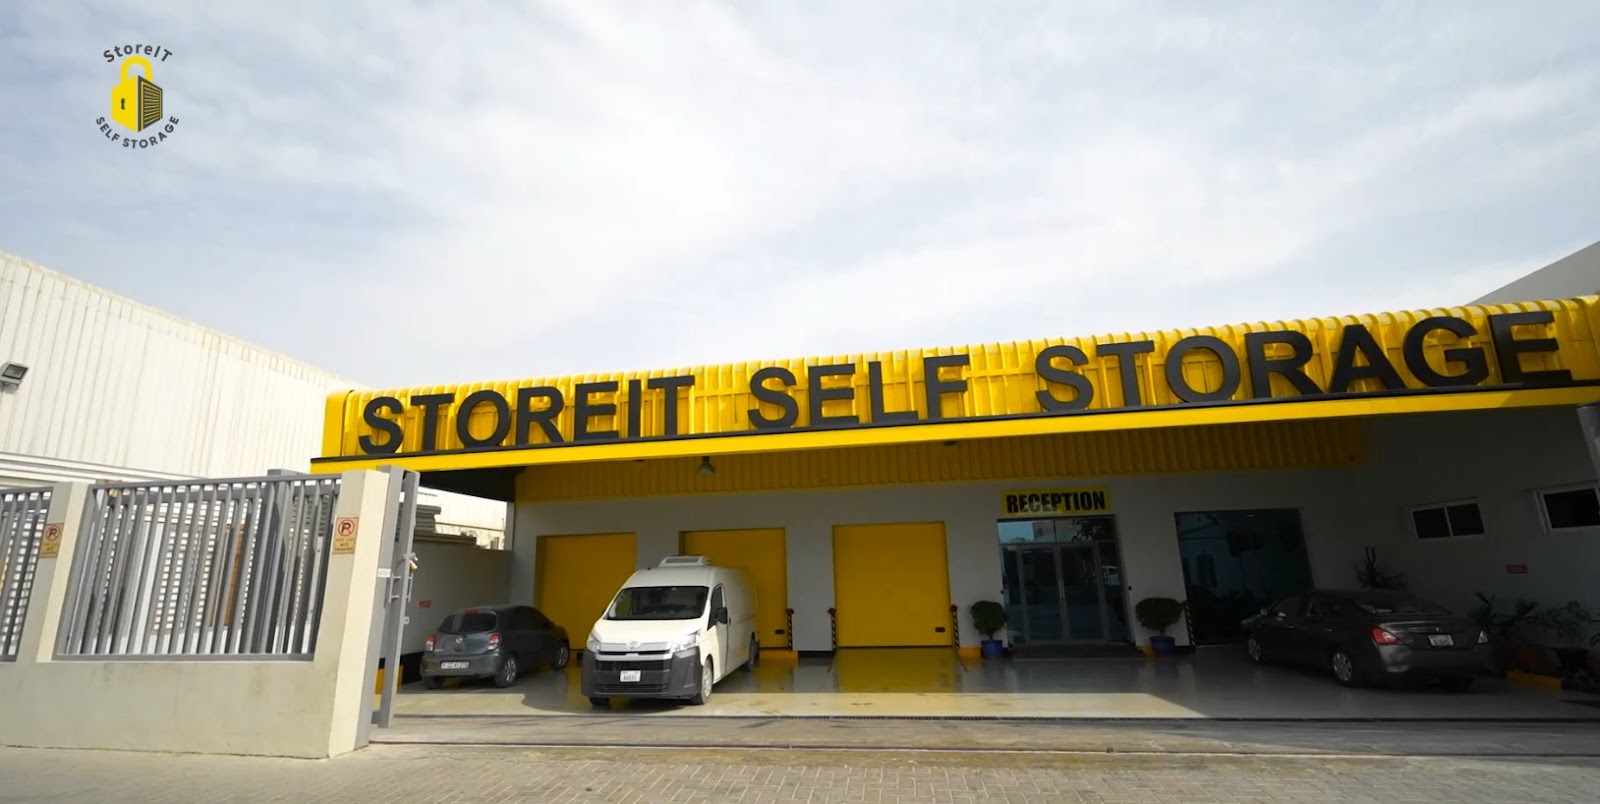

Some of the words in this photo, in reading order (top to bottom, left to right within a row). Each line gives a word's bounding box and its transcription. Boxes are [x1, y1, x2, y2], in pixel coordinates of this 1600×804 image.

[358, 375, 695, 455] STOREIT
[747, 353, 970, 429] SELF
[1035, 311, 1573, 413] STORAGE
[1006, 491, 1106, 513] RECEPTION
